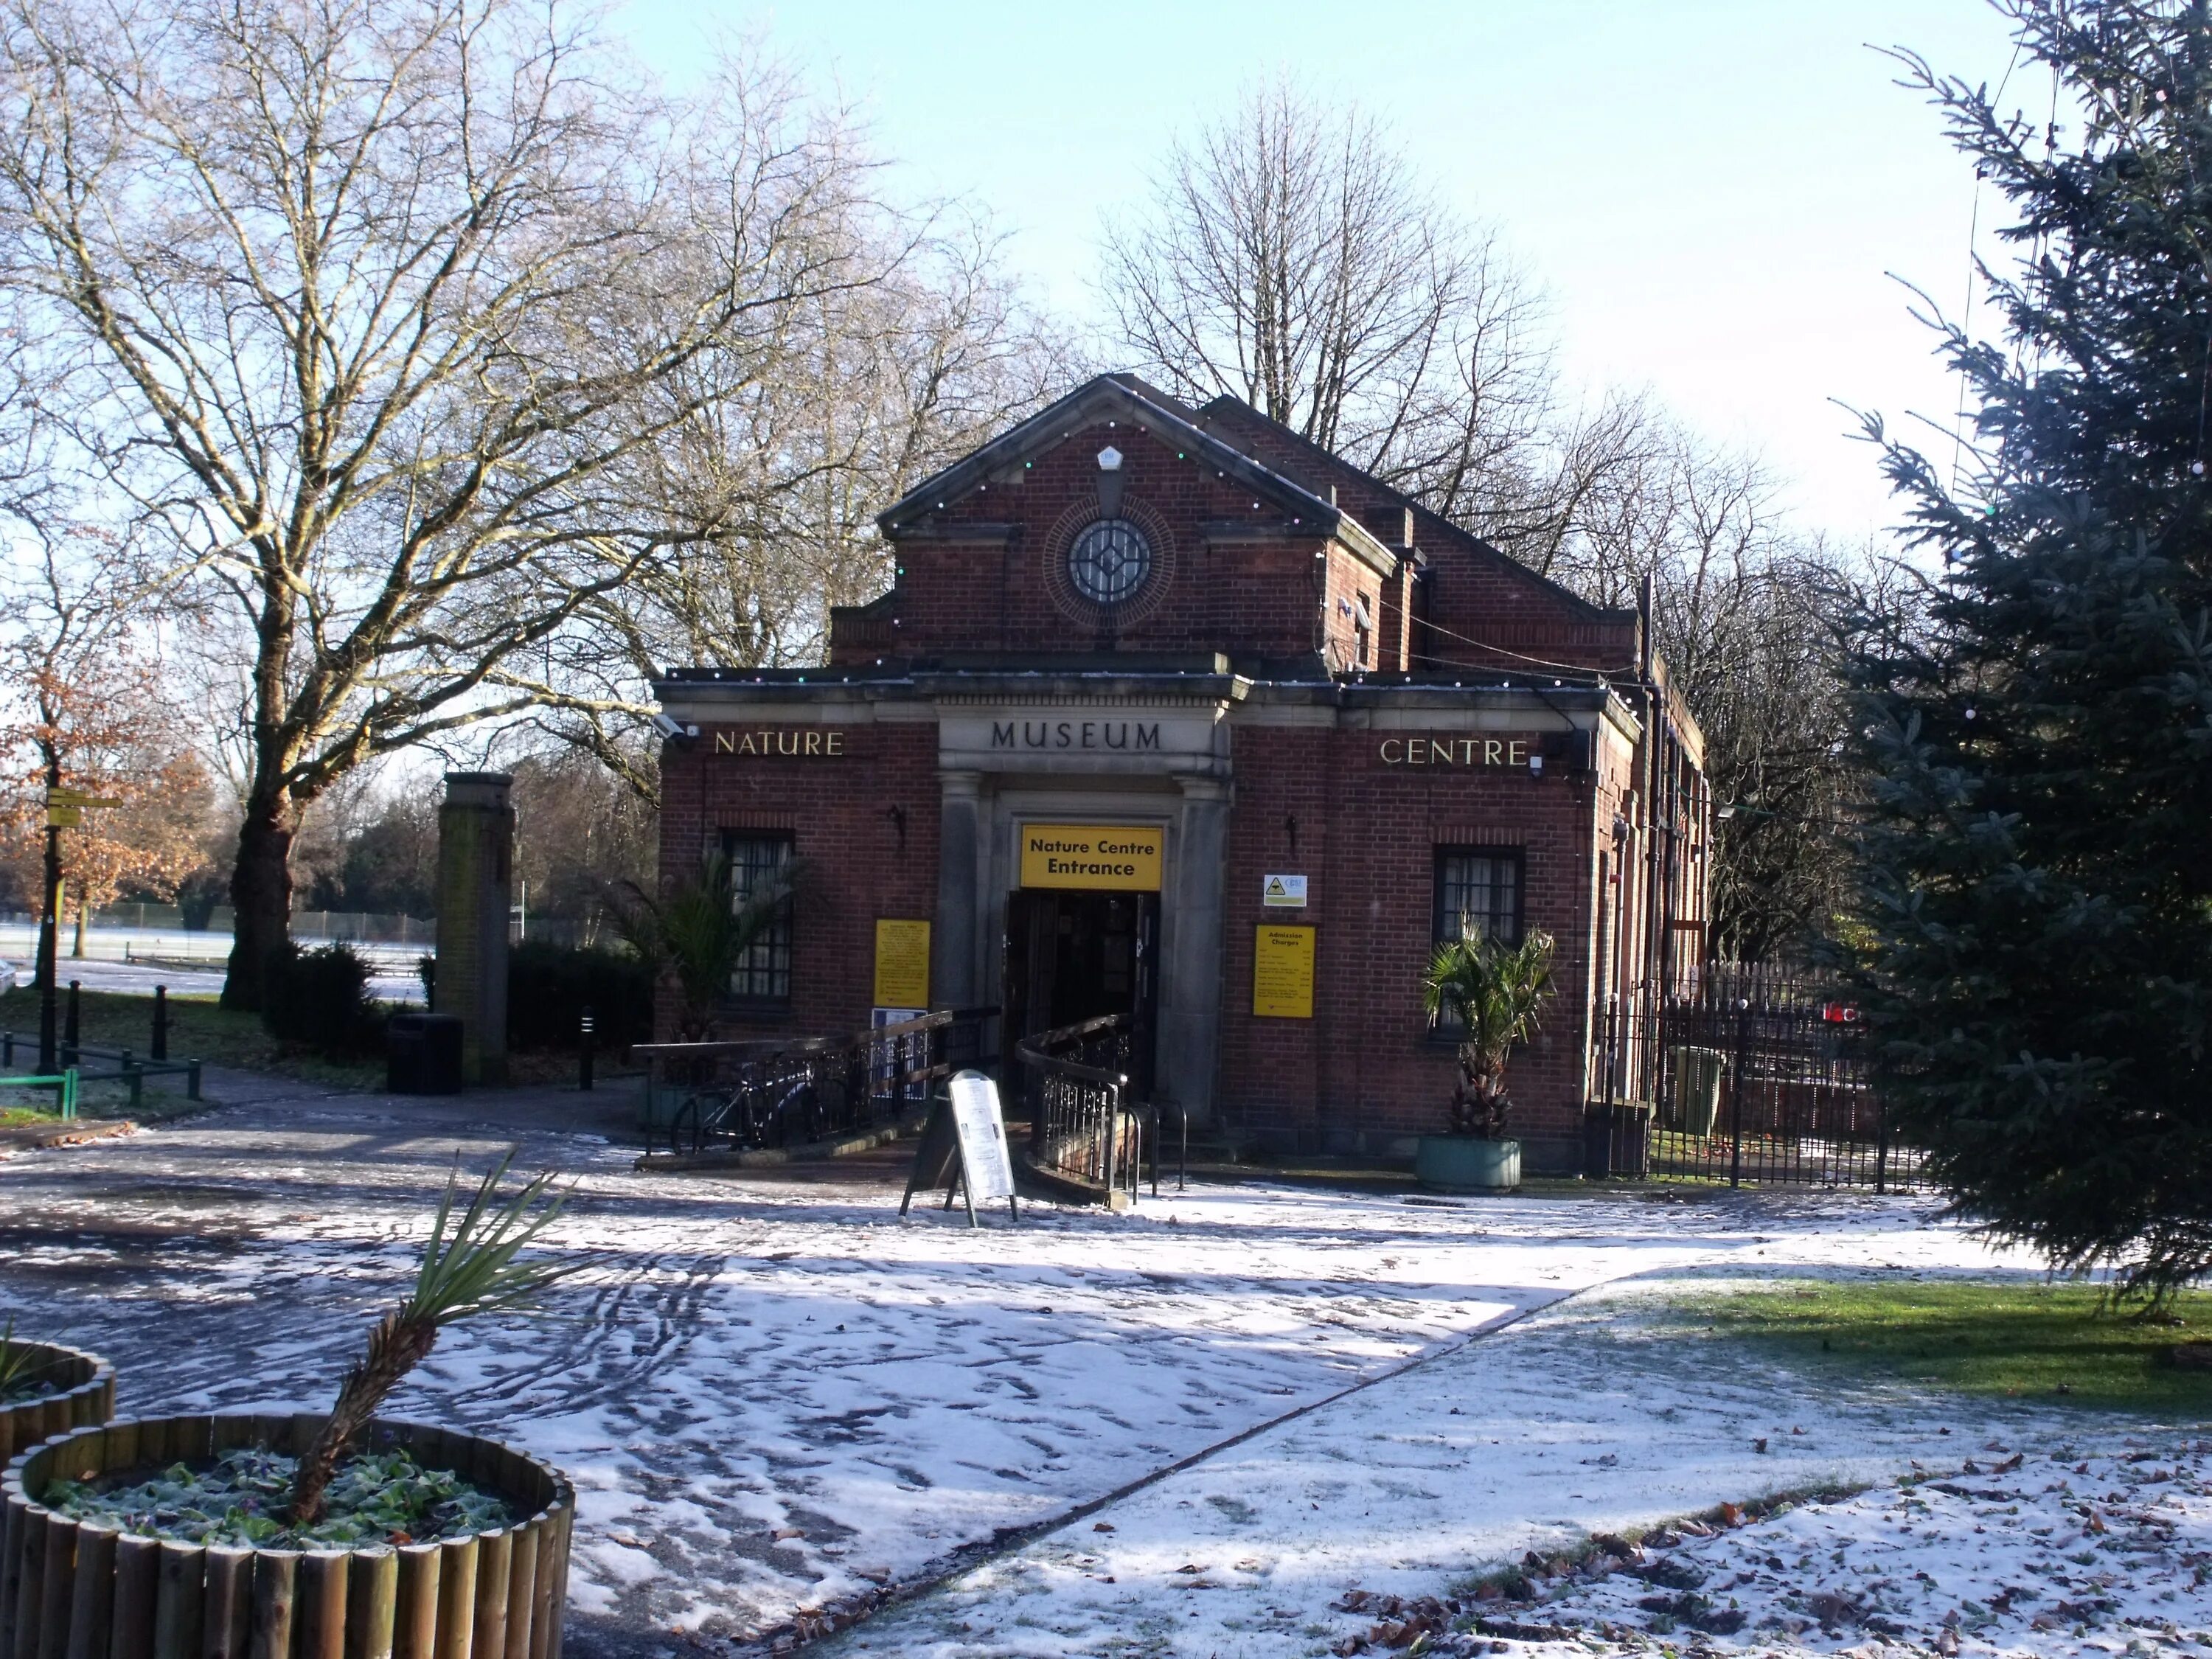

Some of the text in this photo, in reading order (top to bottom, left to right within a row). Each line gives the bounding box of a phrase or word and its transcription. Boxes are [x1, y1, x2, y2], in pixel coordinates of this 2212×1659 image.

[715, 731, 844, 756] NATURE
[992, 721, 1161, 751] MUSEUM
[1380, 738, 1528, 766] CENTRE
[1030, 839, 1155, 855] Nature Centre
[1048, 858, 1135, 876] Entrance
[1268, 931, 1303, 939] Admission
[1271, 939, 1299, 947] Charges
